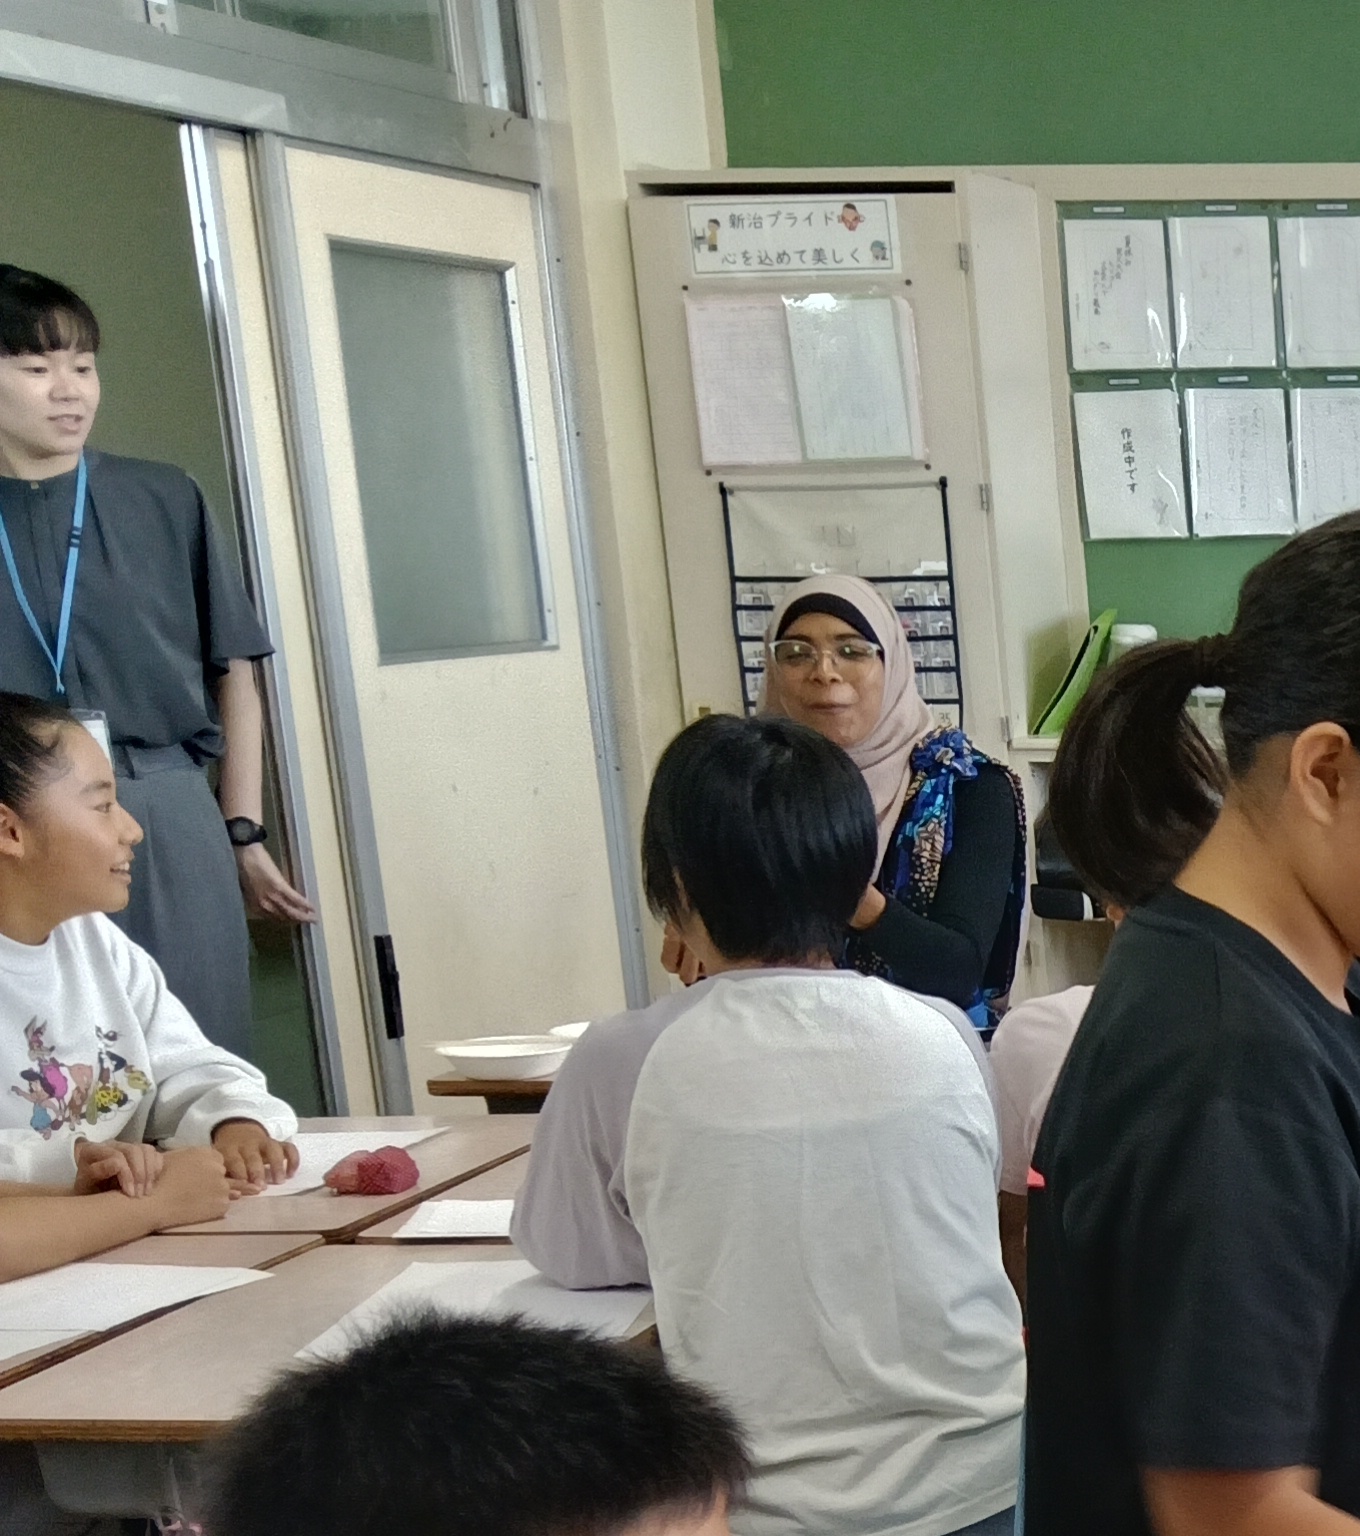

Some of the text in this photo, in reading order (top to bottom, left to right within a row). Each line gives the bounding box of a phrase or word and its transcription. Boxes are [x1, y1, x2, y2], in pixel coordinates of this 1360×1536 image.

[729, 209, 836, 230] 新治プライド
[721, 247, 861, 265] 心を込めて美しく
